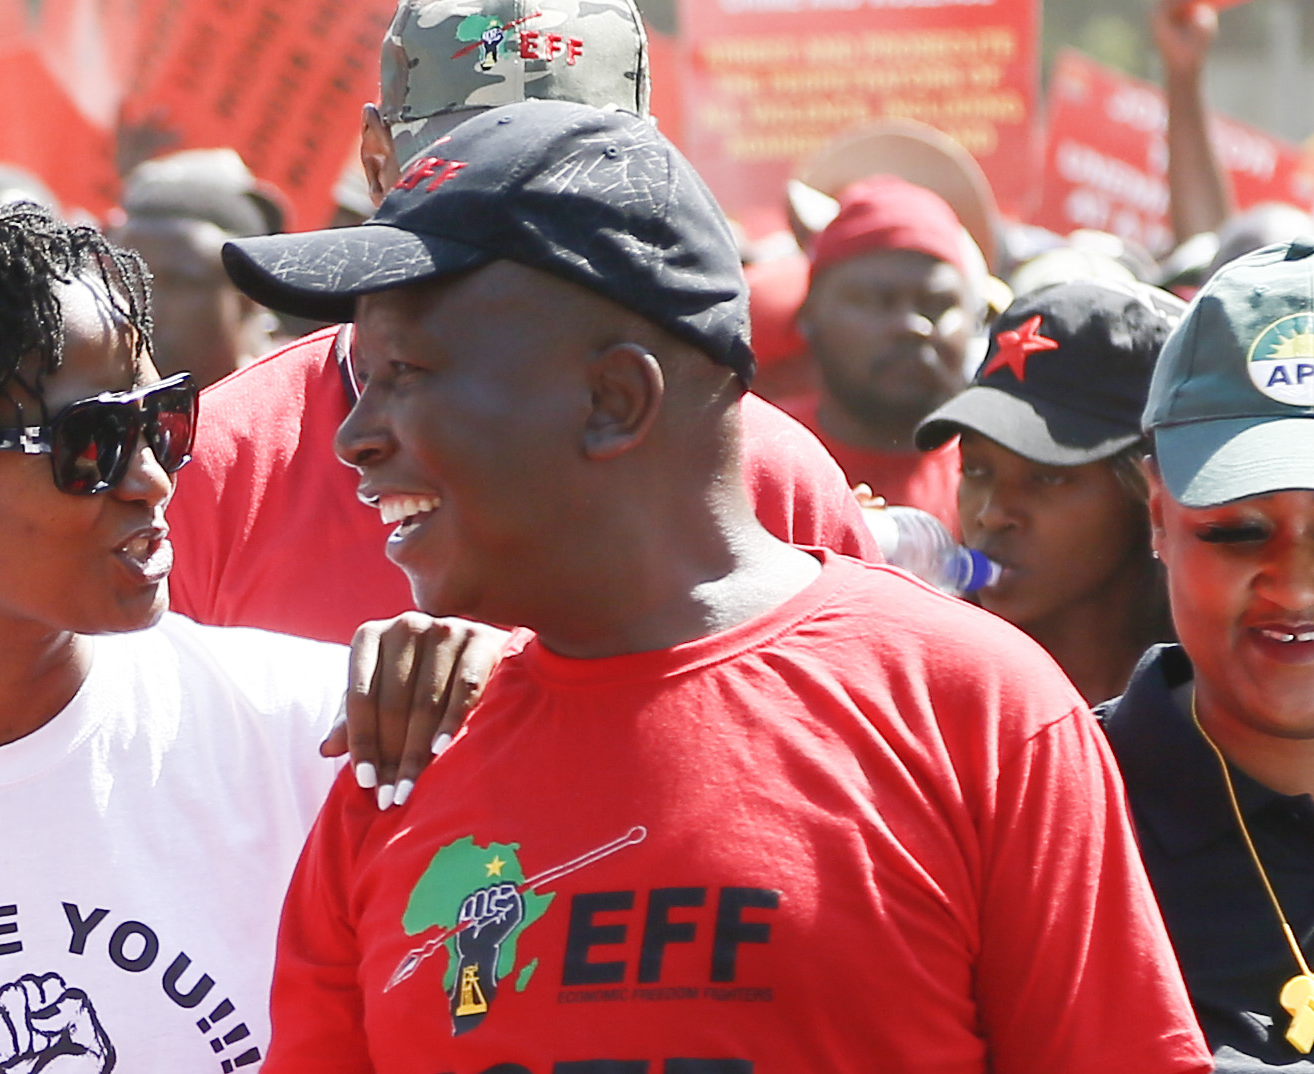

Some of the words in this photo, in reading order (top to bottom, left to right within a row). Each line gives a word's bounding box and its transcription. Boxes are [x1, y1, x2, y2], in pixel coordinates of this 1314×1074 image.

[518, 30, 584, 66] EFF
[561, 886, 781, 986] EFF
[61, 901, 262, 1074] YOU!!!
